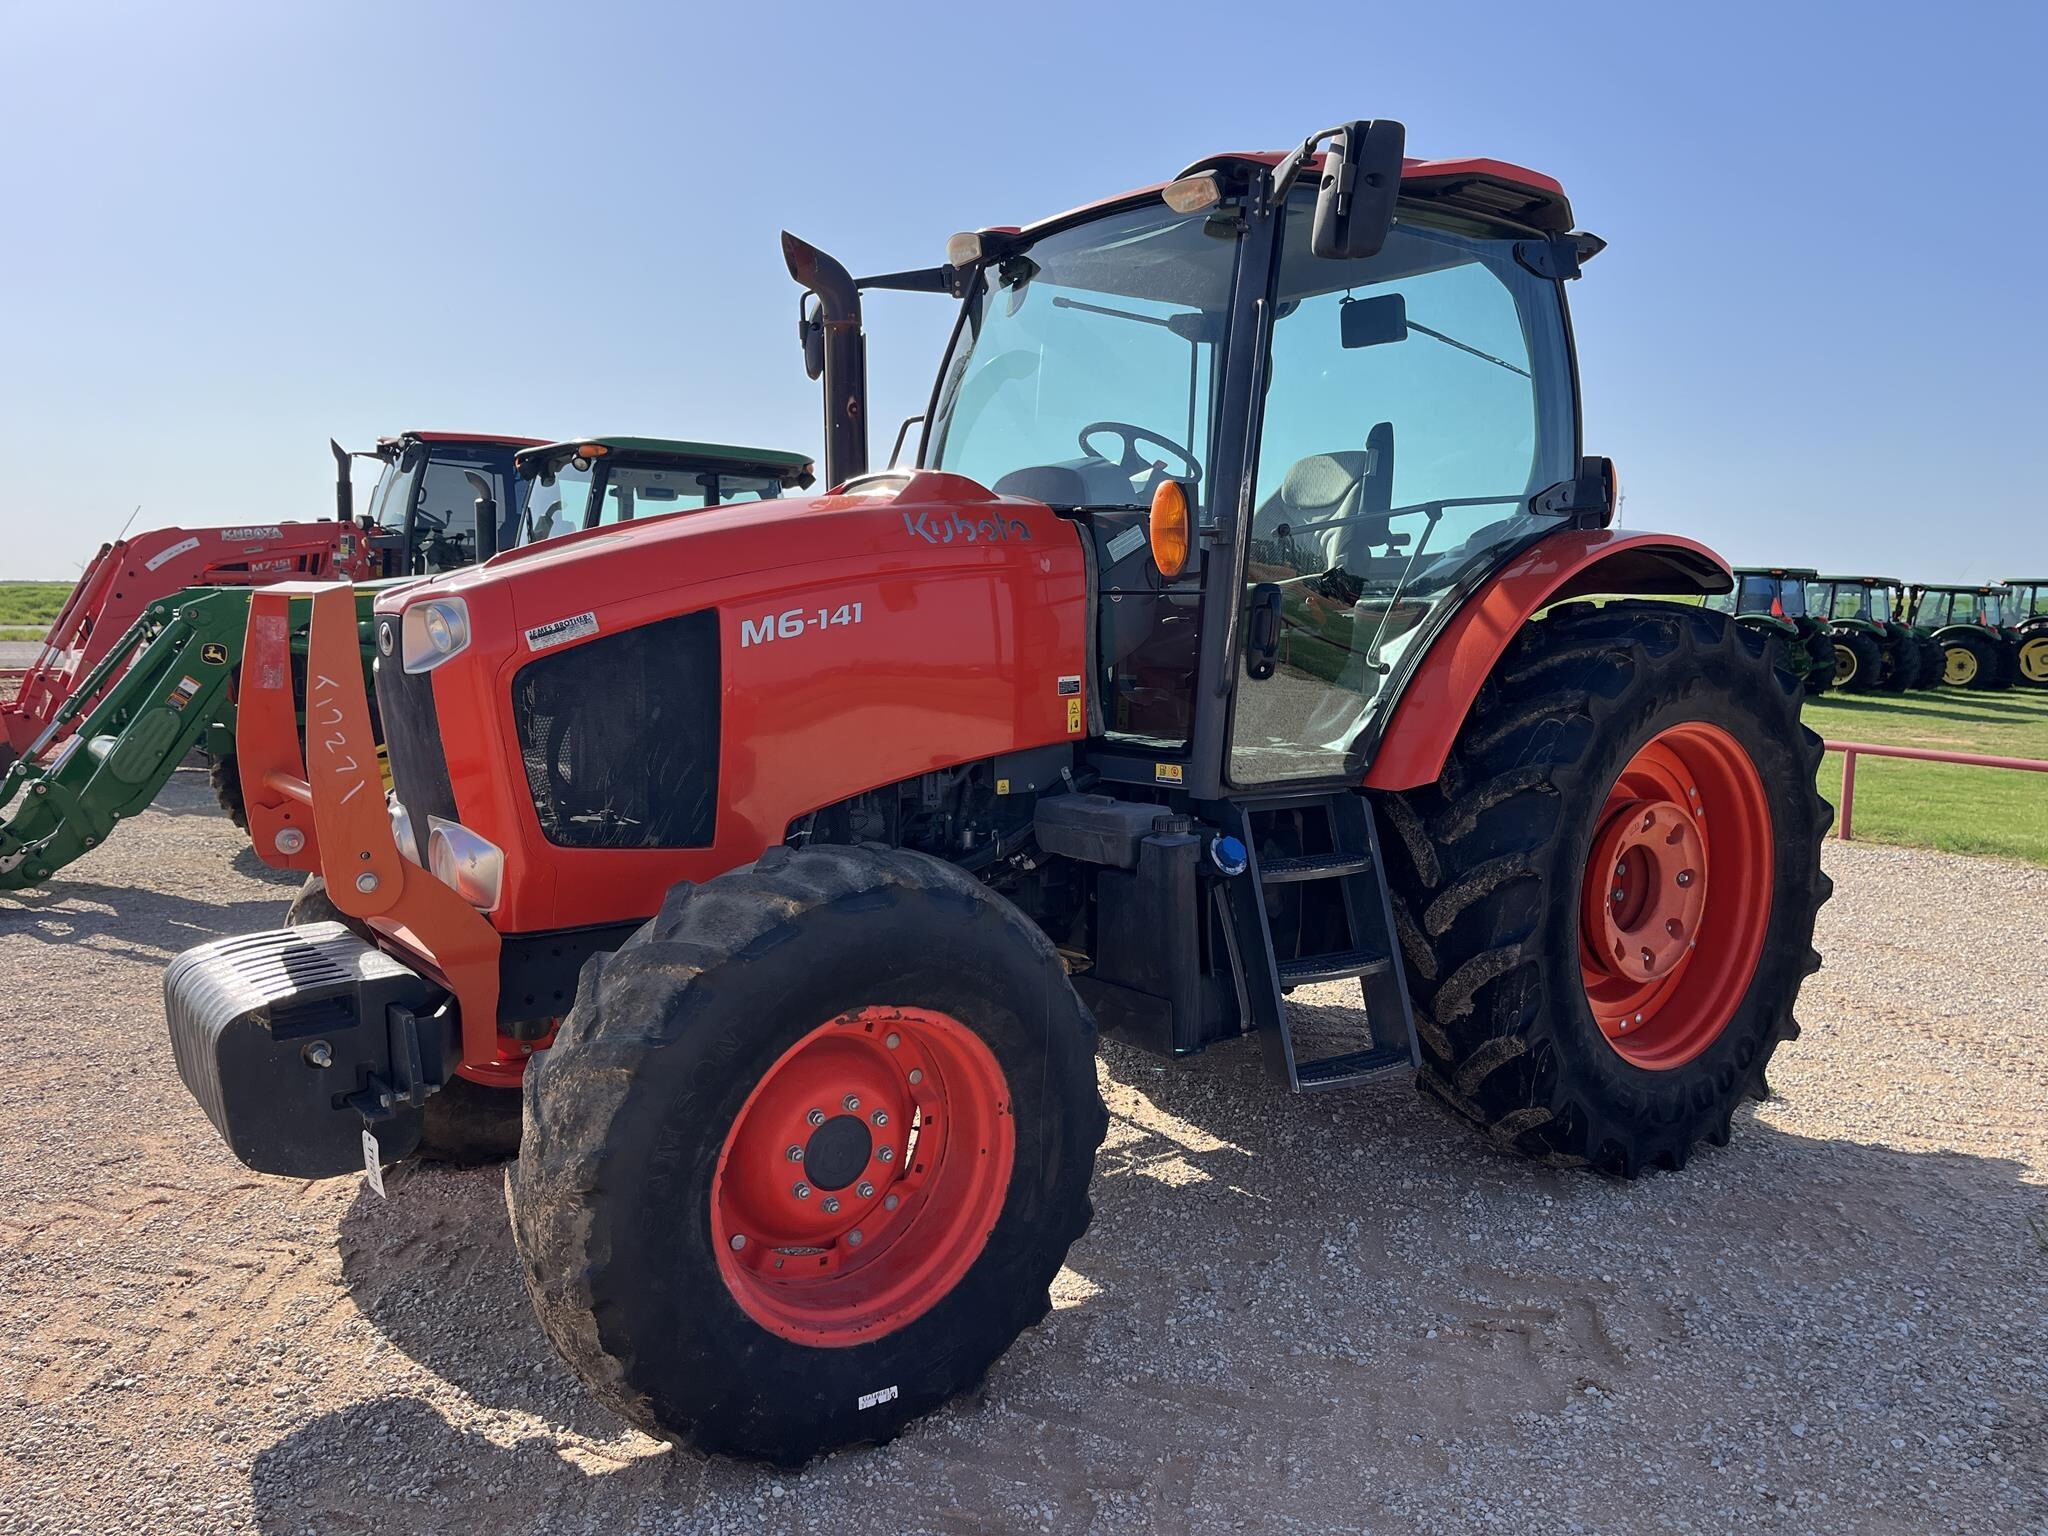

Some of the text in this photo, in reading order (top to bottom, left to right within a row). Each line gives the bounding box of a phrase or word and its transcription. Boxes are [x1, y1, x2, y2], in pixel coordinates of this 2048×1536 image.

[221, 527, 284, 541] KUBOTA
[903, 512, 1032, 543] Kubota
[741, 602, 862, 648] M6-141
